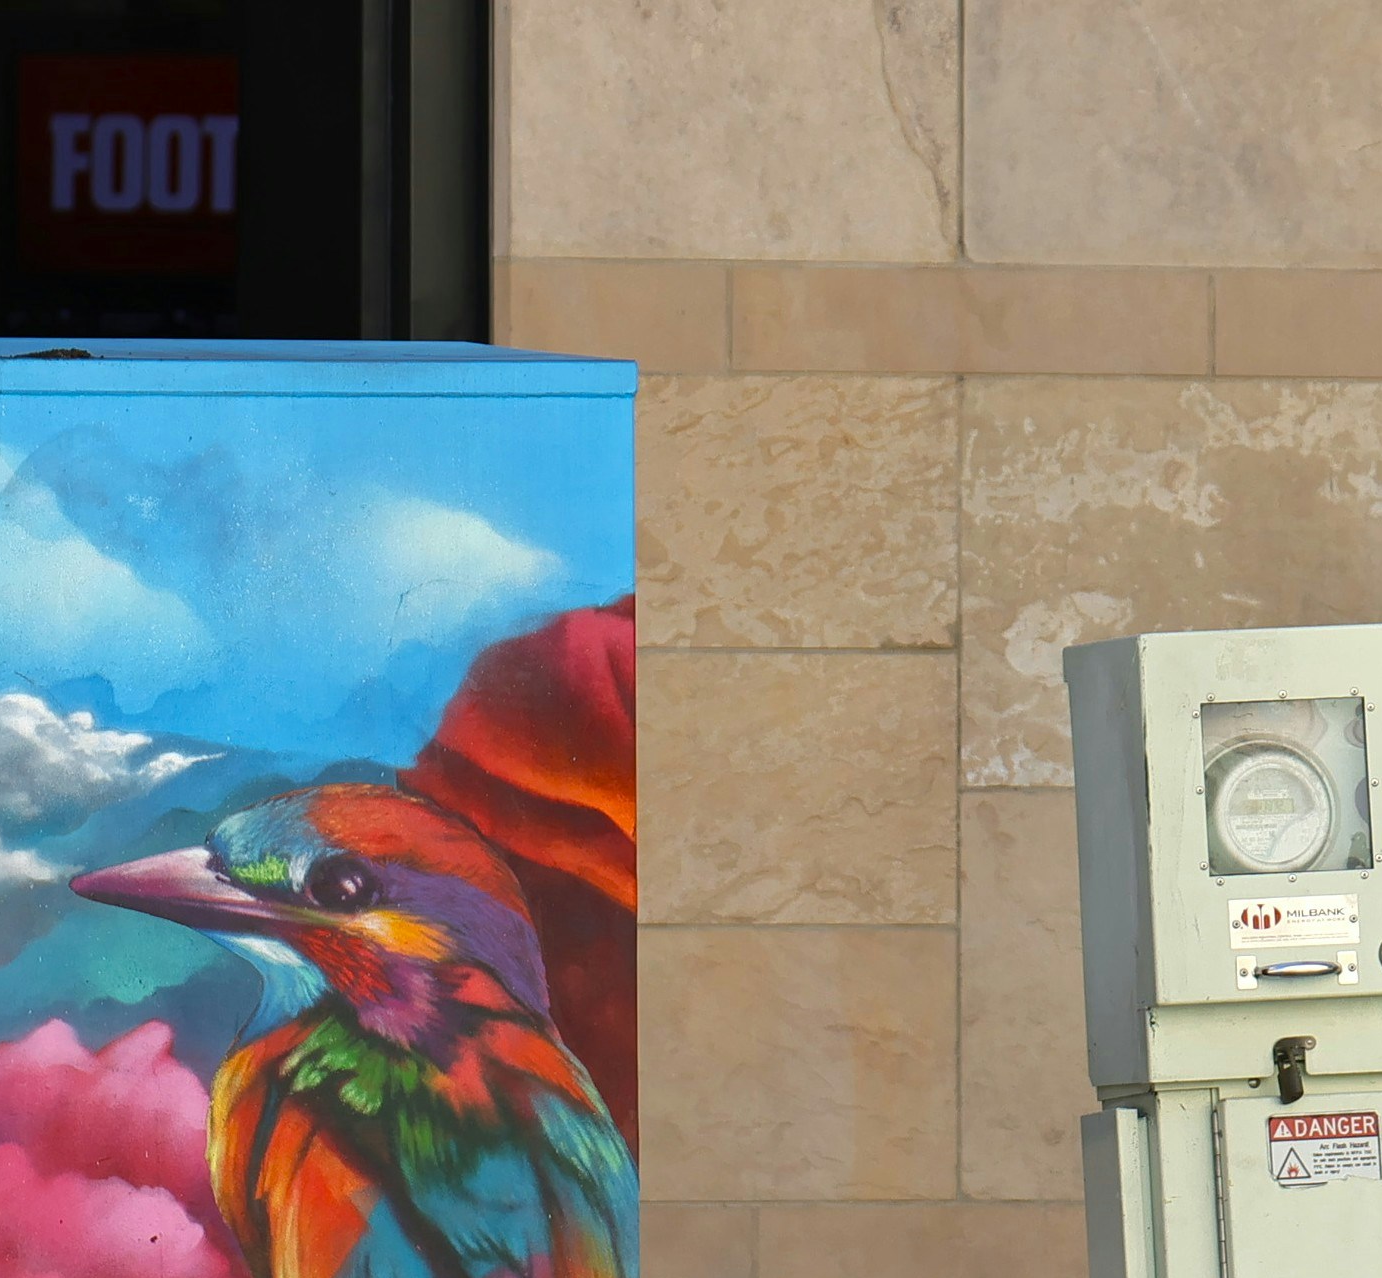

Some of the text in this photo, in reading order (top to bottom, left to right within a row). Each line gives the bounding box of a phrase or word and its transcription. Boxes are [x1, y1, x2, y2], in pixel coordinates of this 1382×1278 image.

[50, 112, 239, 213] FOOT
[1287, 908, 1345, 917] MILBANK
[1294, 1116, 1376, 1137] DANGER
